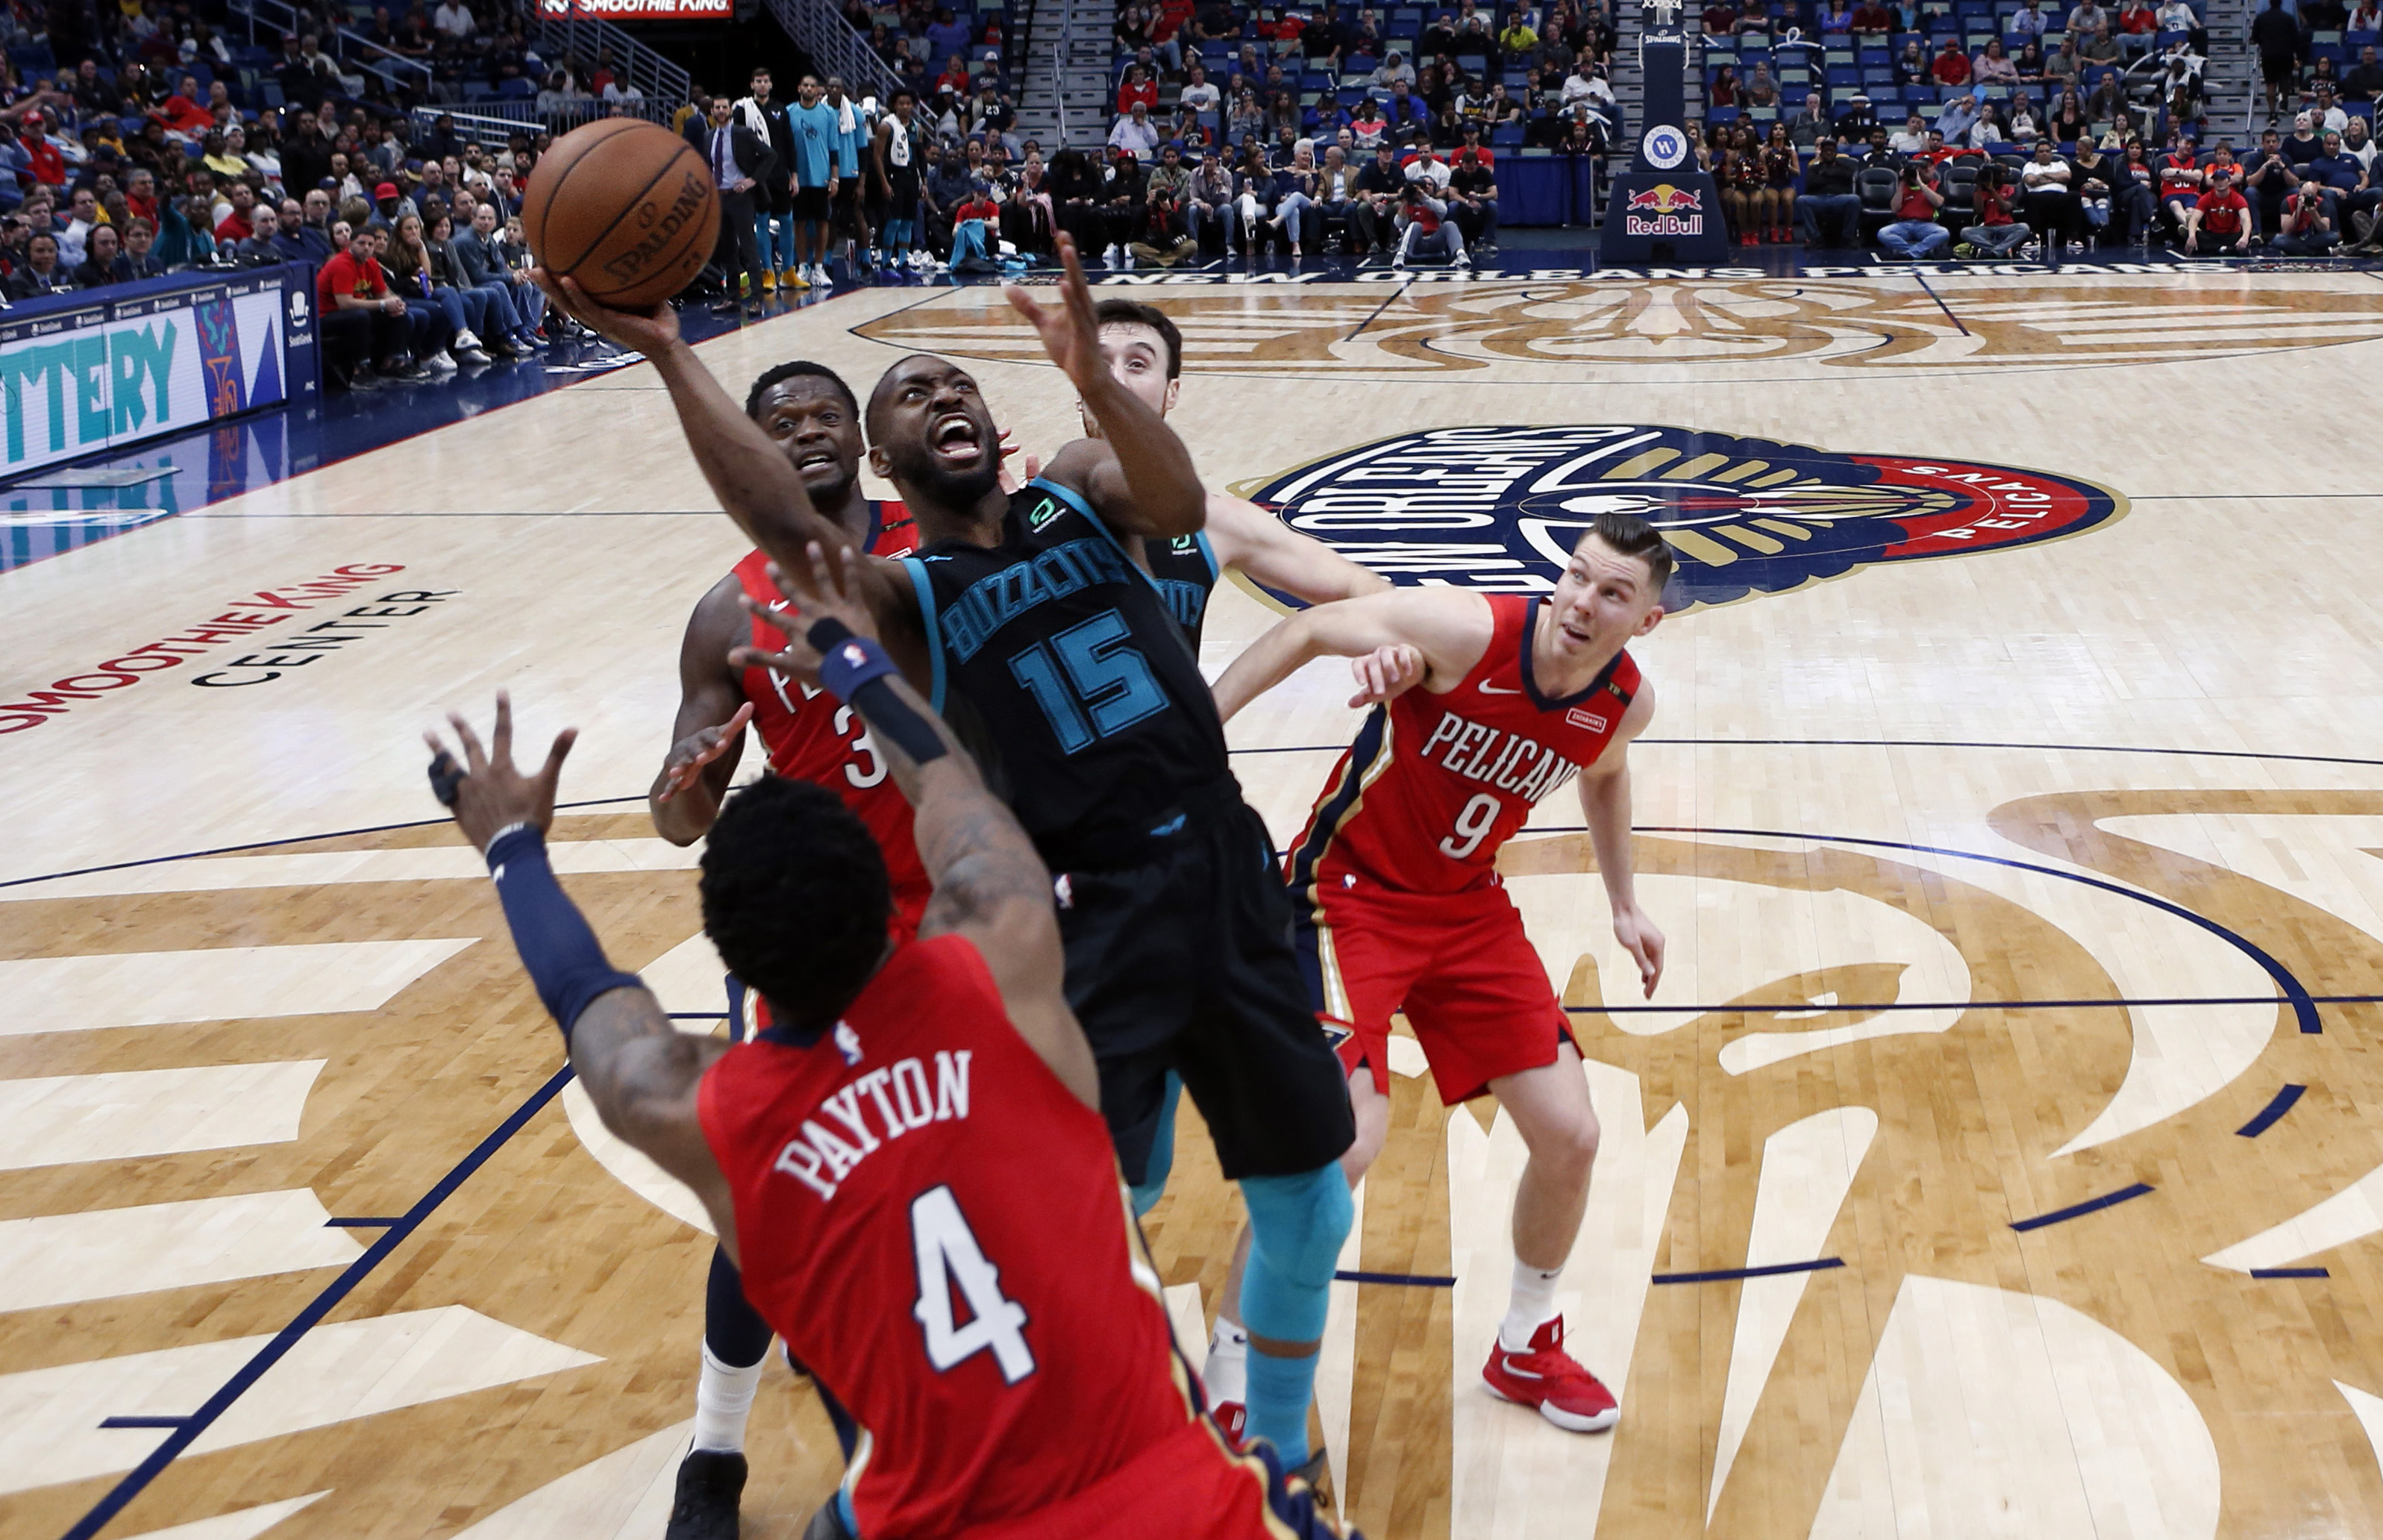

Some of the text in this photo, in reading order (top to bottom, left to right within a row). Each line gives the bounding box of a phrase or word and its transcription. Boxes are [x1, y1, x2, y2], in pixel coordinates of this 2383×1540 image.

[579, 0, 674, 12] SMOOTHIE
[1645, 35, 1681, 44] SPALDING
[986, 105, 1000, 115] 23
[1646, 126, 1684, 143] HANCOCK
[1647, 151, 1684, 168] WHITNEY
[603, 171, 708, 285] SPALDING
[1627, 214, 1703, 235] Red Bull
[1100, 272, 1327, 285] NEW
[1353, 268, 1767, 281] ORLEANS
[1801, 262, 2237, 277] PELICANS
[1291, 426, 1635, 530] ORLEANS
[1902, 466, 2052, 539] PELICANS
[191, 589, 459, 687] CENTER
[1007, 607, 1171, 755] 15
[1438, 792, 1501, 859] 9
[774, 1049, 972, 1202] PAYTON
[909, 1183, 1038, 1387] 4
